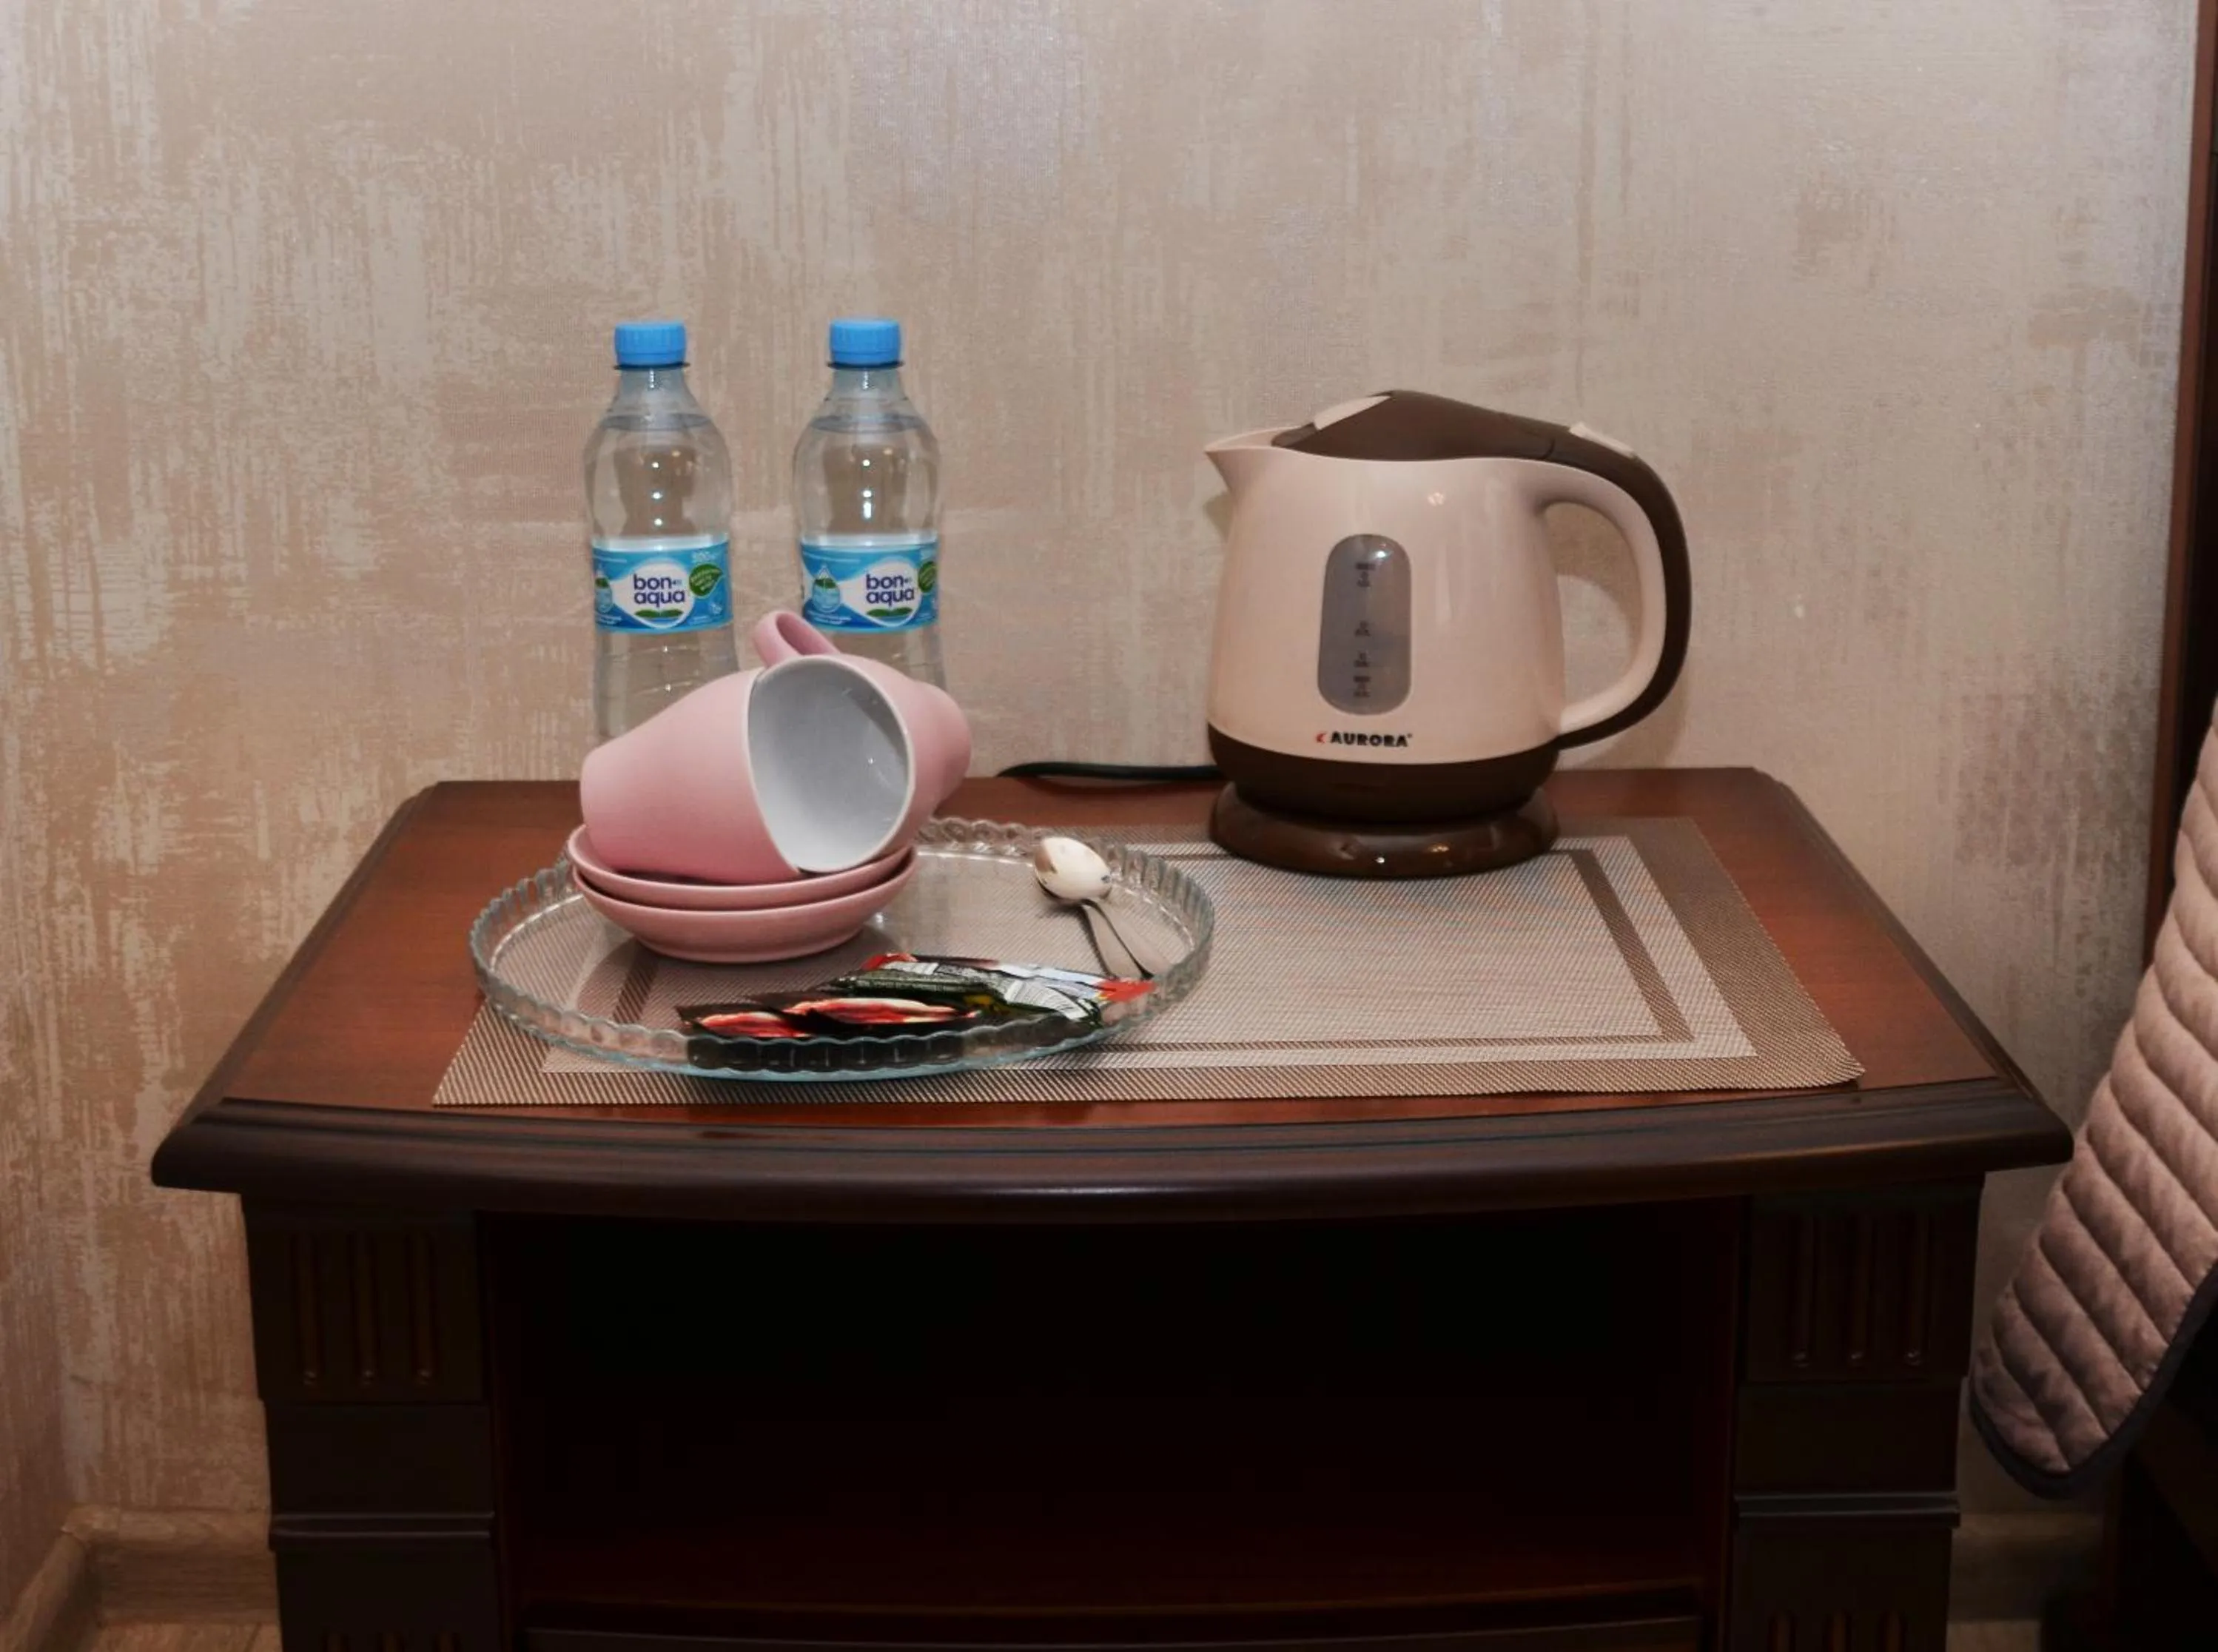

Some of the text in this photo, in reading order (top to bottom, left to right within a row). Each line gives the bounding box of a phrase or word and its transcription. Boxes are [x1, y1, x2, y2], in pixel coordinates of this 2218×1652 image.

[634, 591, 685, 608] aqua
[866, 588, 915, 606] aqua
[1330, 731, 1408, 747] AURORA
